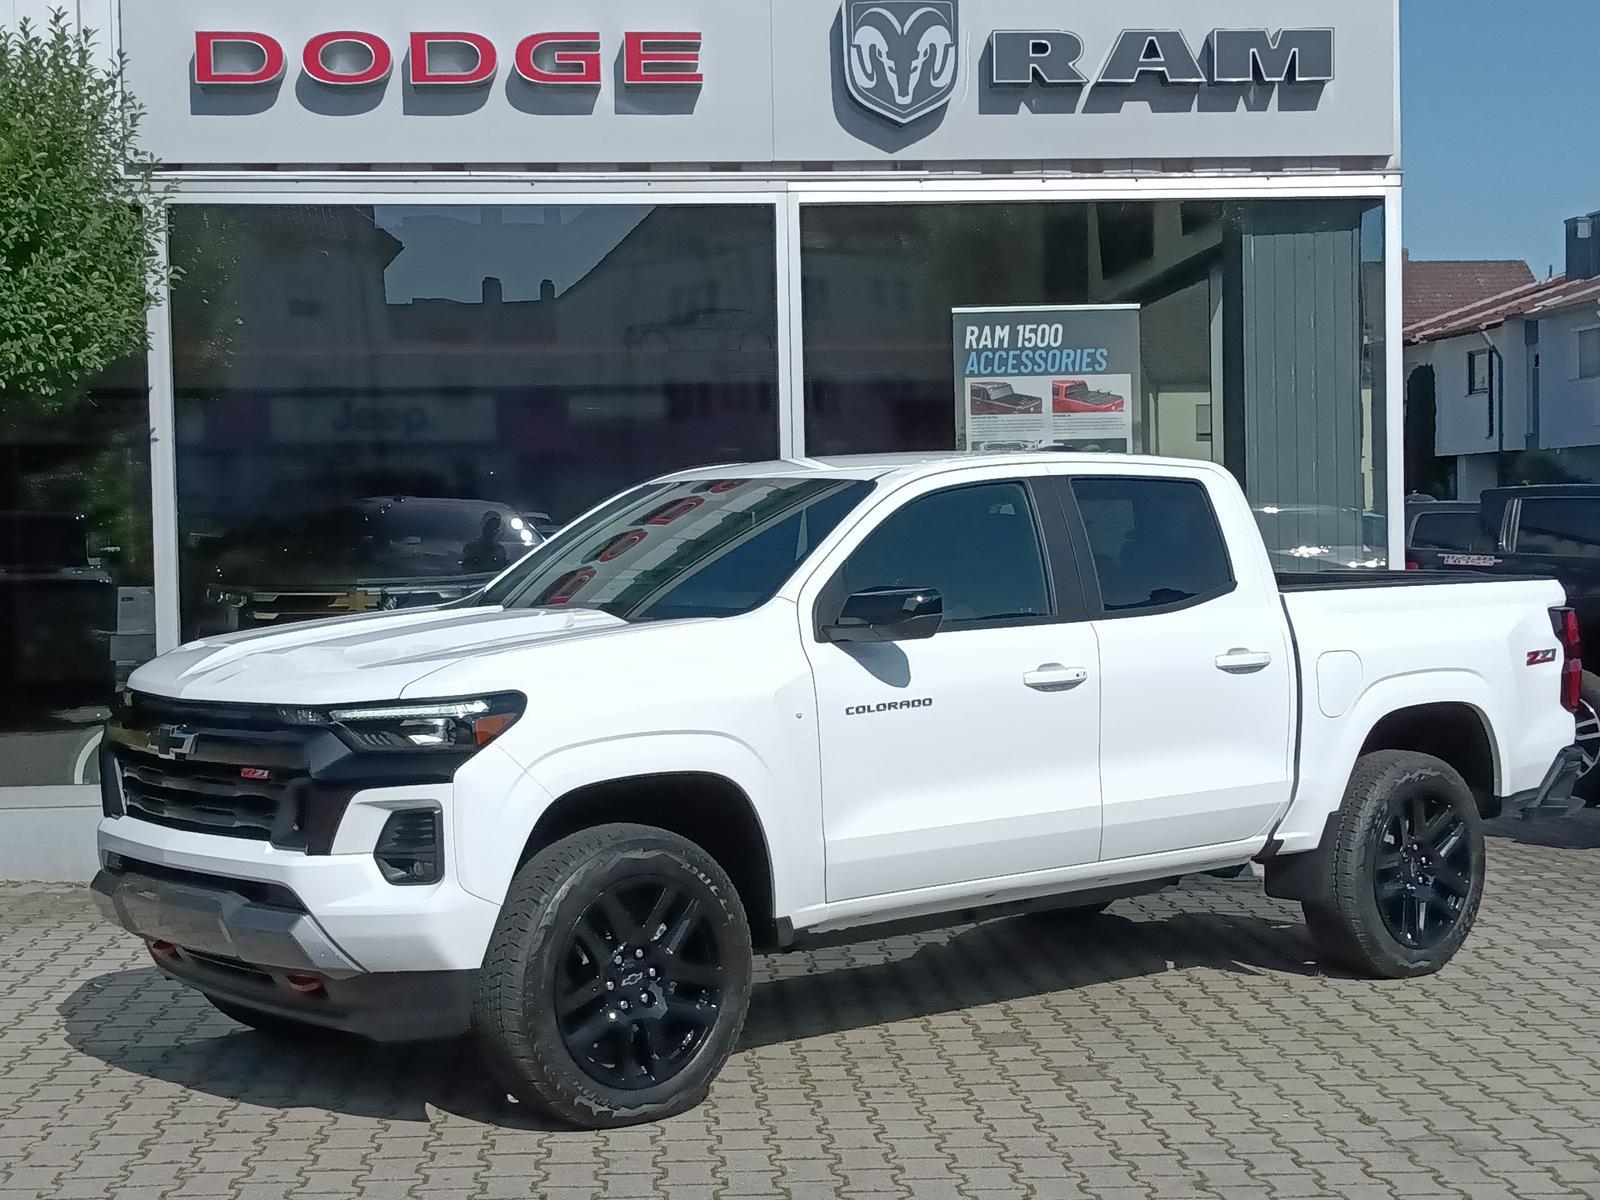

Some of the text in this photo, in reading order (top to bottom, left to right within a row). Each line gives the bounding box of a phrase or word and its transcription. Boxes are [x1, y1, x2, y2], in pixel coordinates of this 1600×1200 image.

[195, 31, 703, 84] DODGE
[993, 28, 1334, 83] RAM
[964, 323, 1063, 349] RAM 1500
[965, 348, 1108, 375] ACCESSORIES
[845, 698, 932, 716] COLORADO
